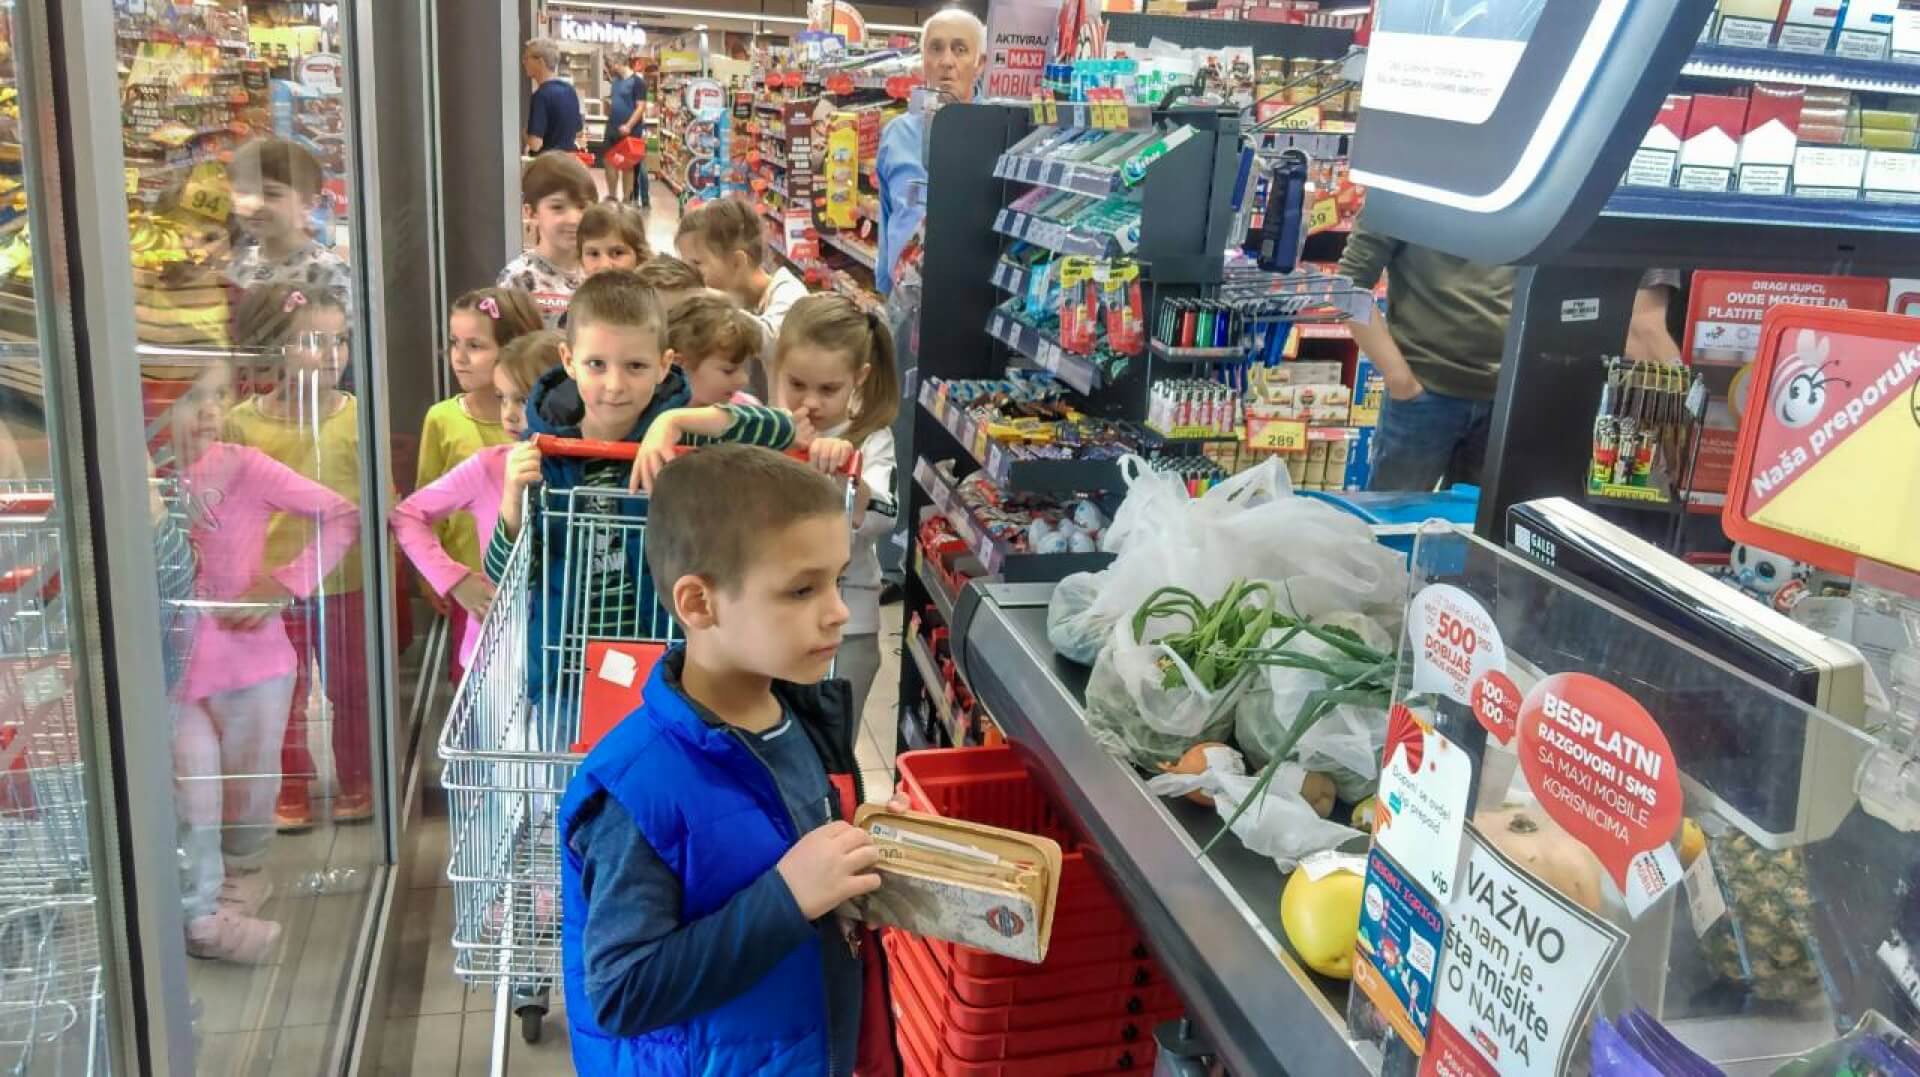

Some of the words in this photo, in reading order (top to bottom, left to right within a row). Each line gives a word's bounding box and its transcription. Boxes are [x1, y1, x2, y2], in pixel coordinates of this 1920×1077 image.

[560, 14, 646, 48] Kuhinja
[996, 33, 1049, 46] AKTIVIRAJ
[1009, 51, 1043, 67] MAXI
[1727, 291, 1765, 305] OVDE
[1768, 292, 1825, 307] MOŽETE
[1827, 297, 1849, 309] DA
[1752, 280, 1786, 291] DRAGI
[1707, 306, 1764, 321] PLATITE
[1267, 434, 1295, 446] 289
[1751, 446, 1808, 498] Naša
[1808, 344, 1920, 456] preporuk
[1437, 610, 1477, 655] 500
[1424, 633, 1472, 675] DOBIJAŠ
[1481, 678, 1504, 705] 100
[1481, 697, 1504, 725] 100
[1542, 692, 1663, 781] BESPLATNI
[1537, 721, 1617, 783] RAZGOVORI
[1617, 770, 1624, 787] I
[1625, 774, 1658, 806] SMS
[1538, 745, 1555, 770] SA
[1557, 757, 1593, 791] MAXI
[1593, 780, 1650, 829] MOBILE
[1543, 773, 1632, 846] KORISNICIMA
[1431, 869, 1449, 896] vip
[1468, 861, 1565, 964] VAŽNO
[1469, 914, 1510, 968] nam
[1511, 951, 1534, 987] je
[1443, 921, 1473, 969] šta
[1476, 958, 1549, 1043] mislite
[1448, 964, 1464, 993] O
[1468, 981, 1531, 1068] NAMA
